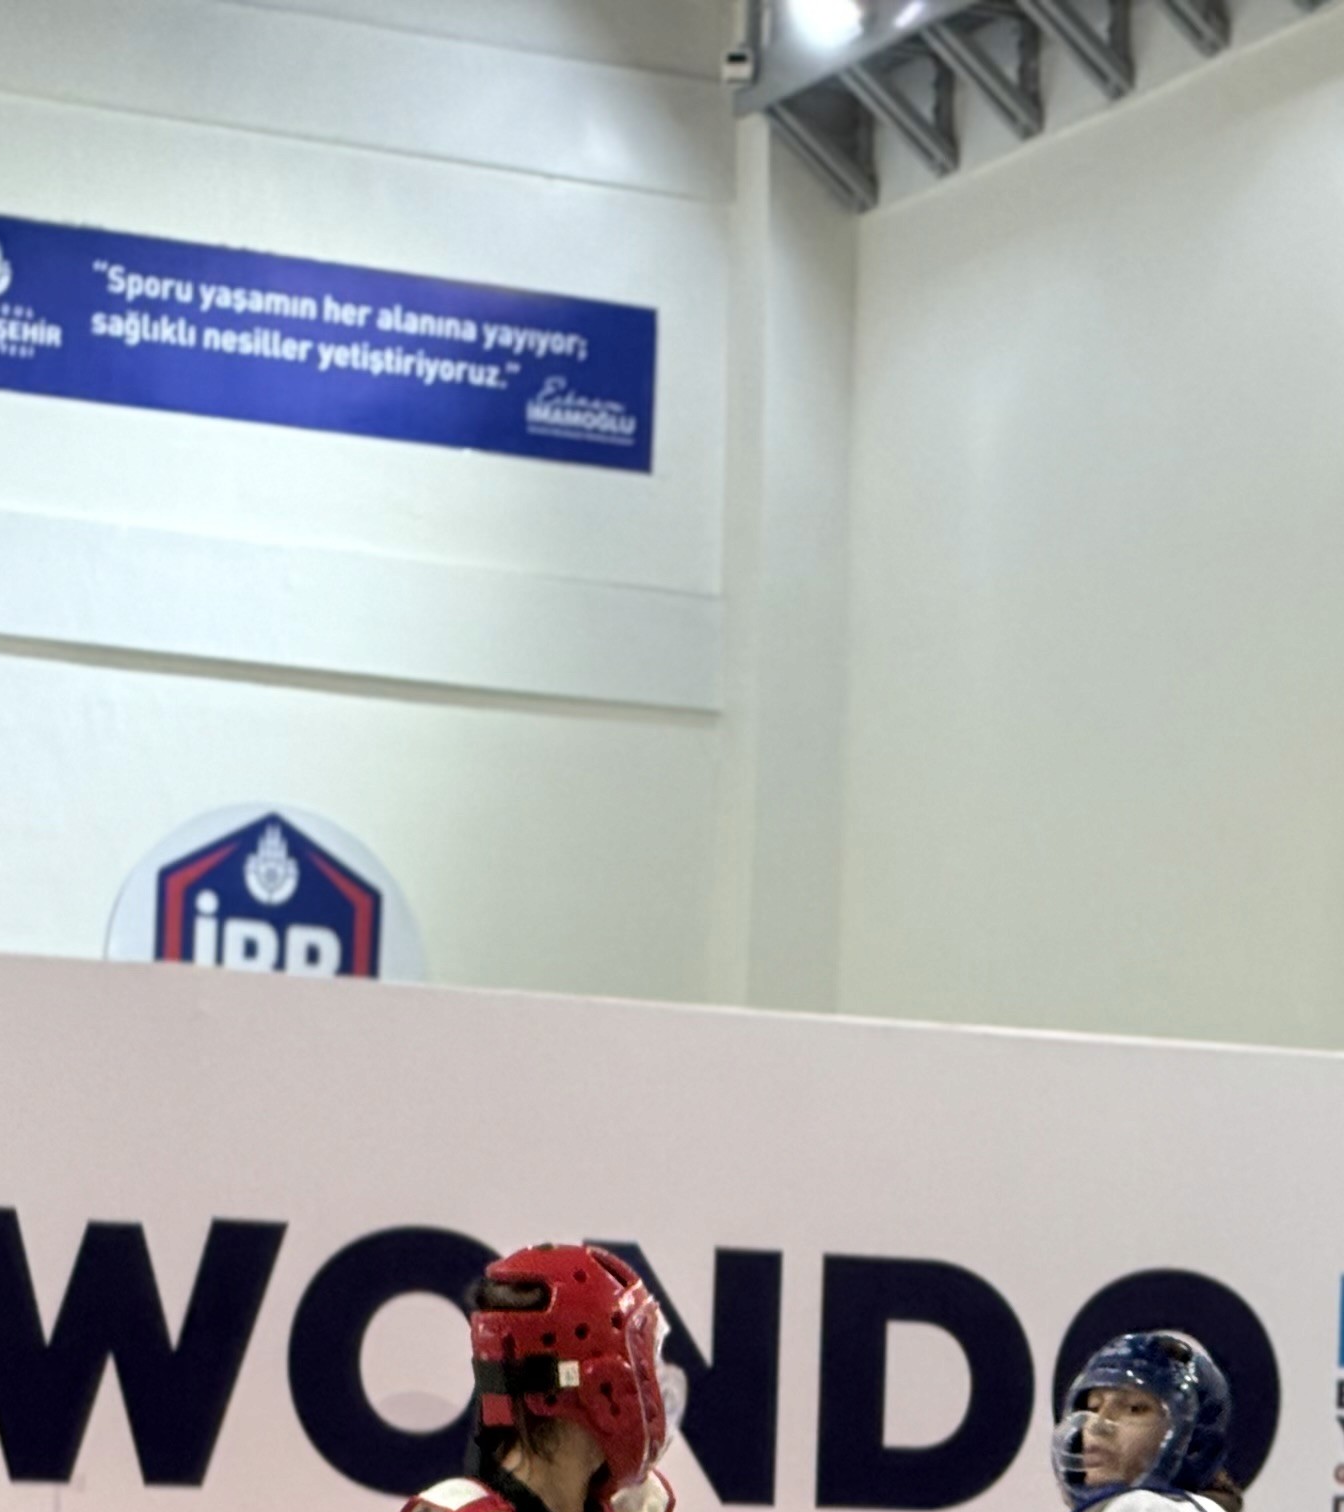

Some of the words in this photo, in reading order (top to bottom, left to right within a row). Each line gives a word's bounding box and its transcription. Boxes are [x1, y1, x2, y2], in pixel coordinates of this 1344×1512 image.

[91, 308, 198, 348] sağlıklı
[203, 325, 313, 363] nesiller
[92, 259, 194, 303] “Sporu
[199, 282, 318, 321] yaşamın
[322, 293, 373, 328] her
[377, 304, 477, 343] alanına
